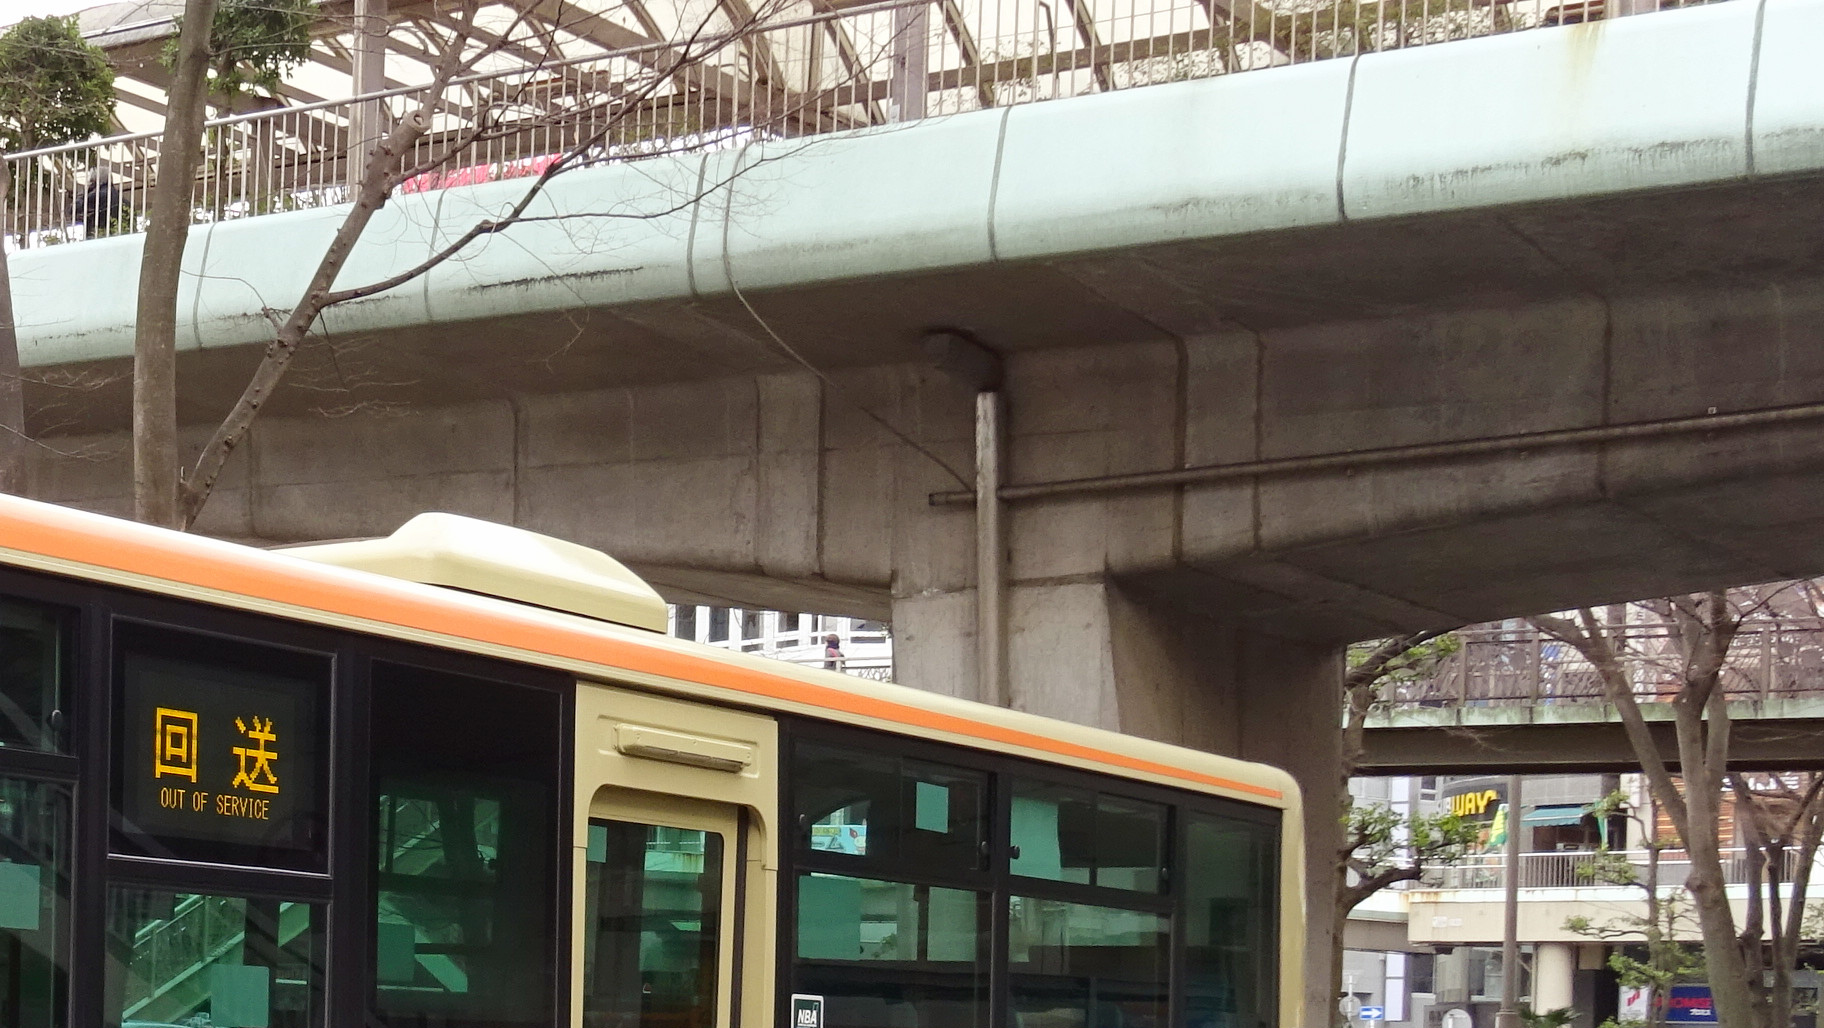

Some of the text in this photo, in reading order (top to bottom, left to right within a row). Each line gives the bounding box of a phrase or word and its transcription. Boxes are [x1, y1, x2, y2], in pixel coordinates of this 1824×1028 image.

[155, 707, 279, 793] 回送
[159, 787, 270, 821] OUT OF SERVICE
[797, 1009, 817, 1025] NBA
